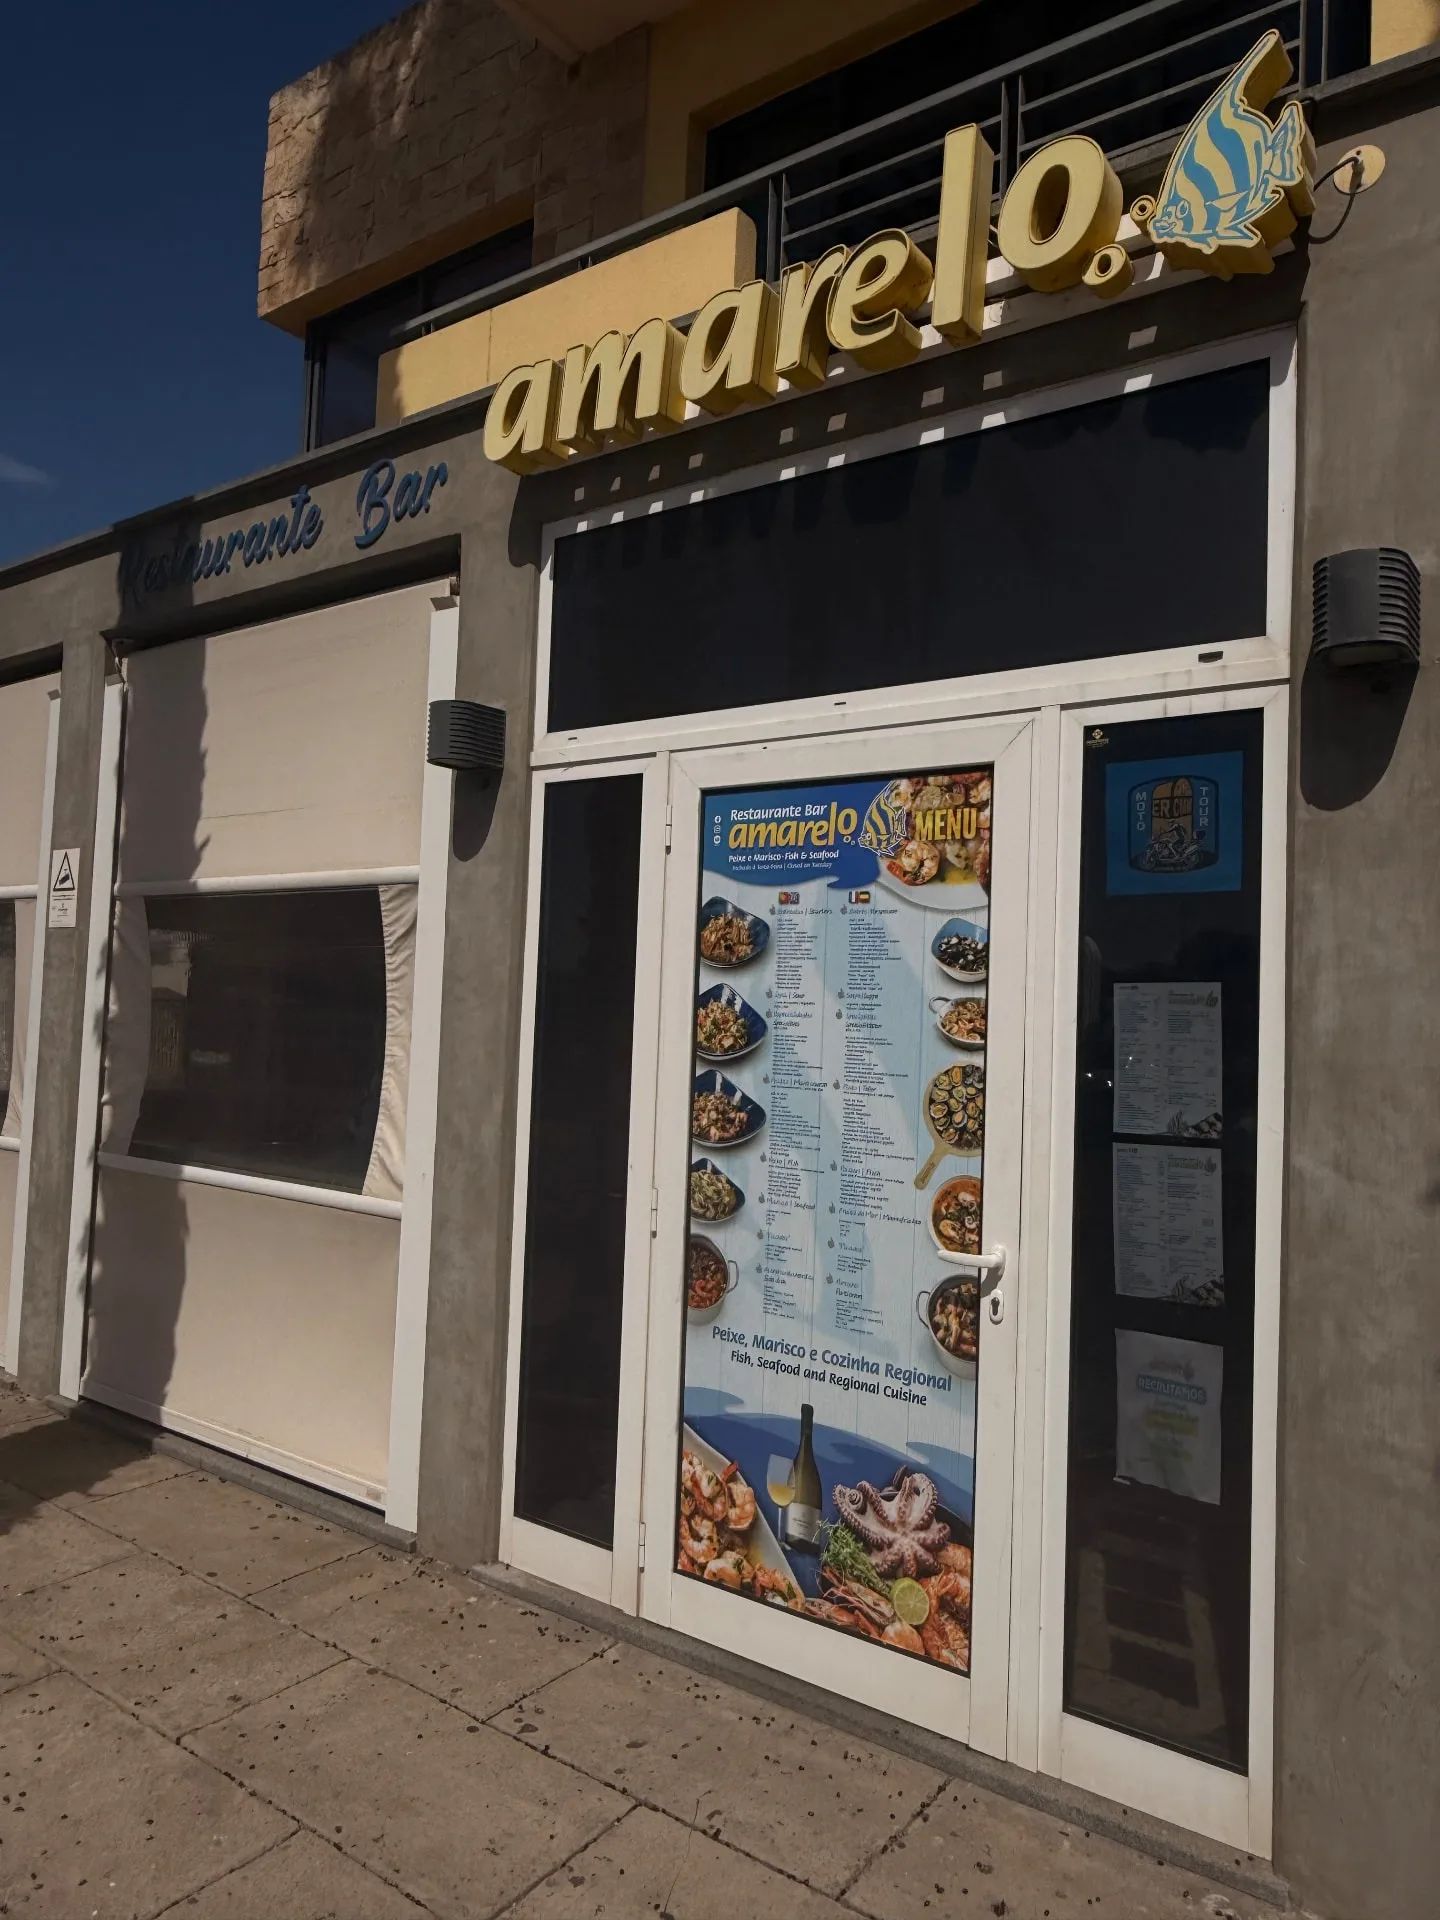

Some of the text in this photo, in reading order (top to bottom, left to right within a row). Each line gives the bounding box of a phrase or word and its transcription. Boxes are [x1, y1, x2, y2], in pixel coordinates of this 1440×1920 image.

[483, 123, 1124, 476] amarelo
[122, 459, 448, 604] Restaurante Bar
[728, 801, 858, 849] amarelo
[731, 803, 828, 821] Restaurante Bar
[915, 807, 977, 841] MENU
[1199, 786, 1209, 827] TOUR
[809, 850, 839, 861] Seafood
[712, 1326, 952, 1392] Peixe, Marisco e Cozinha Regional
[731, 1350, 928, 1406] Fish, Seafood and Regional Cuisine
